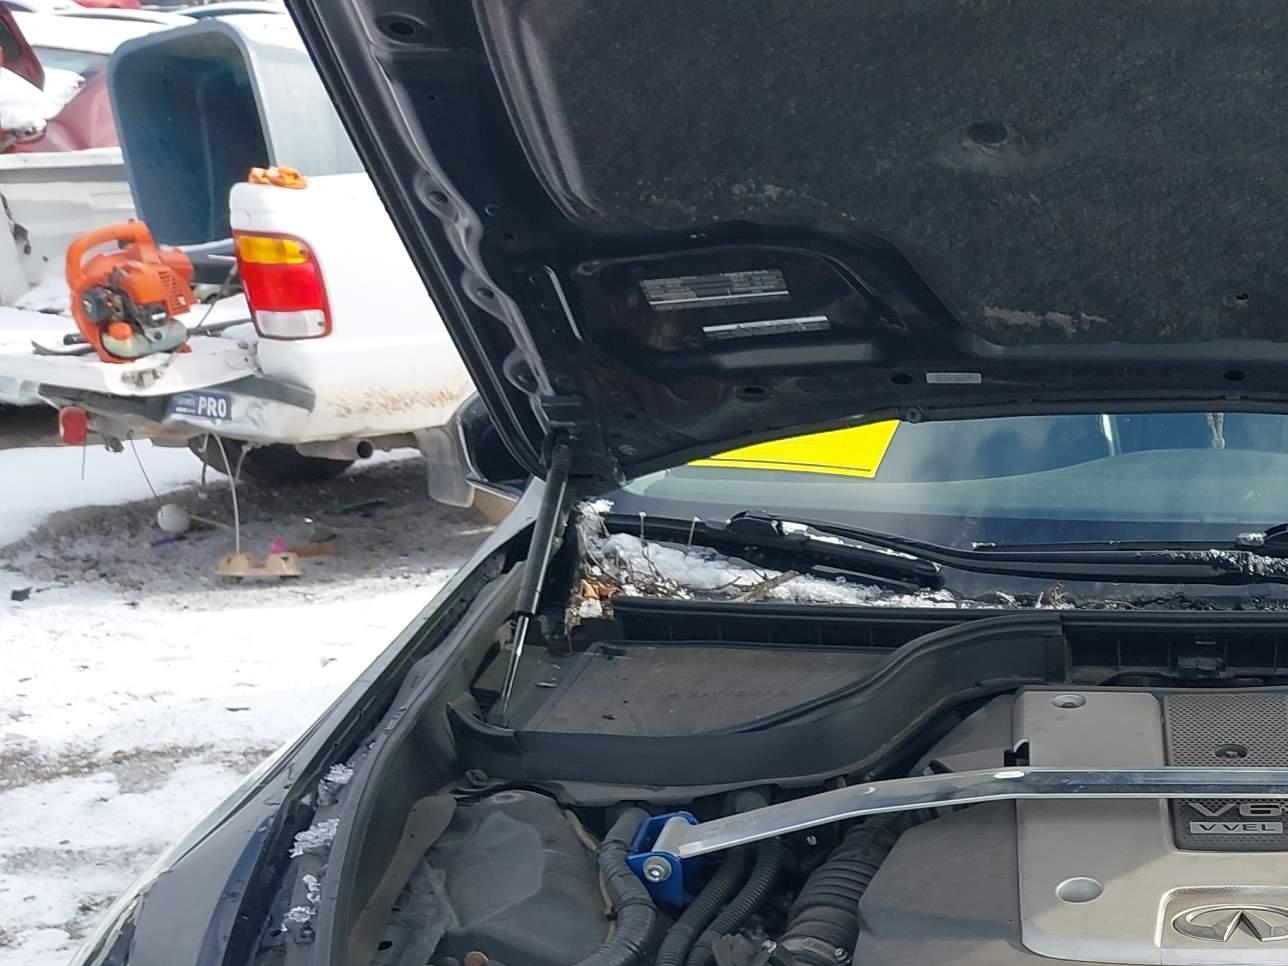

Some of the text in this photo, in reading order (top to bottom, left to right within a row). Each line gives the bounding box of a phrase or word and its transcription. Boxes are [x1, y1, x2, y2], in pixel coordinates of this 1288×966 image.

[198, 396, 227, 418] PRO
[1187, 802, 1282, 817] V6
[1199, 823, 1276, 832] VVEL
